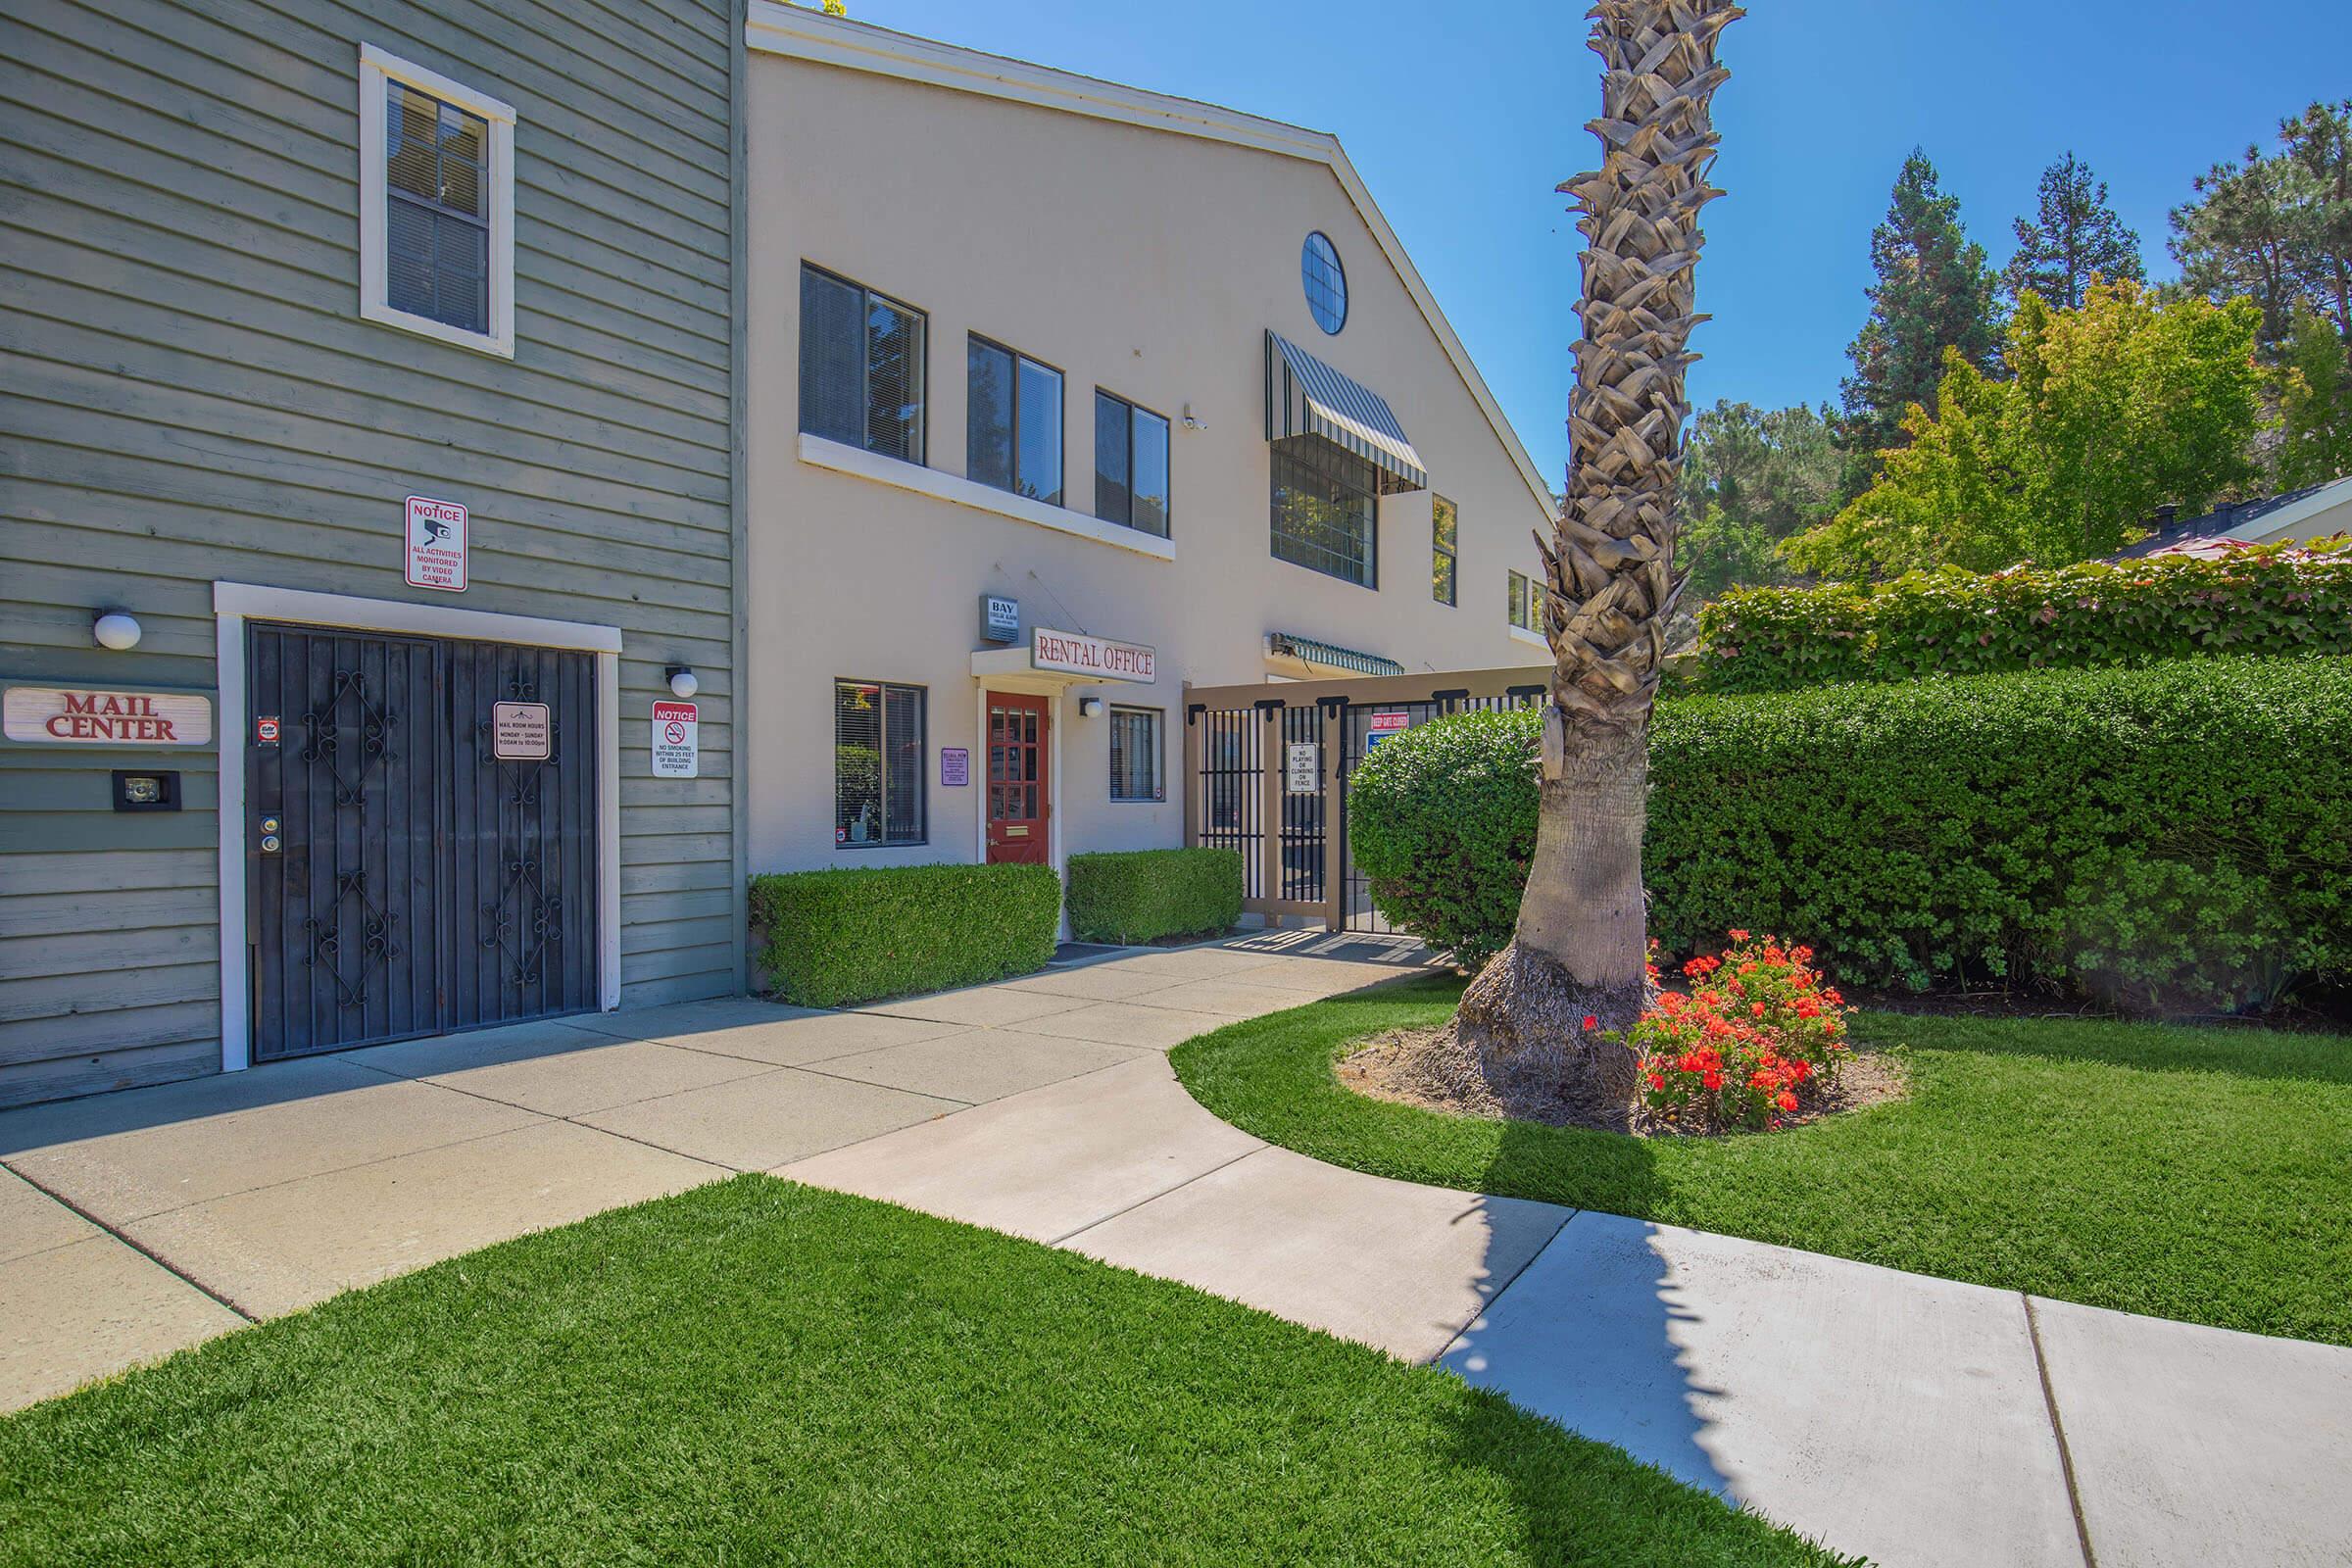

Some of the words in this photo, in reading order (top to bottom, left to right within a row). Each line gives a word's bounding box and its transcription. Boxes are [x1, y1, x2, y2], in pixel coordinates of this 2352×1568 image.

[414, 505, 461, 521] NOTICE
[426, 548, 462, 559] ACTIVITIES
[416, 556, 458, 567] MONITORED
[432, 566, 453, 575] VIDEO
[422, 574, 452, 584] CAMERA
[992, 602, 1013, 613] BAY
[1039, 636, 1101, 667] RENTAL
[1103, 647, 1152, 675] OFFICE
[63, 692, 159, 717] MAIL
[657, 710, 695, 721] NOTICE
[46, 715, 177, 741] CENTER
